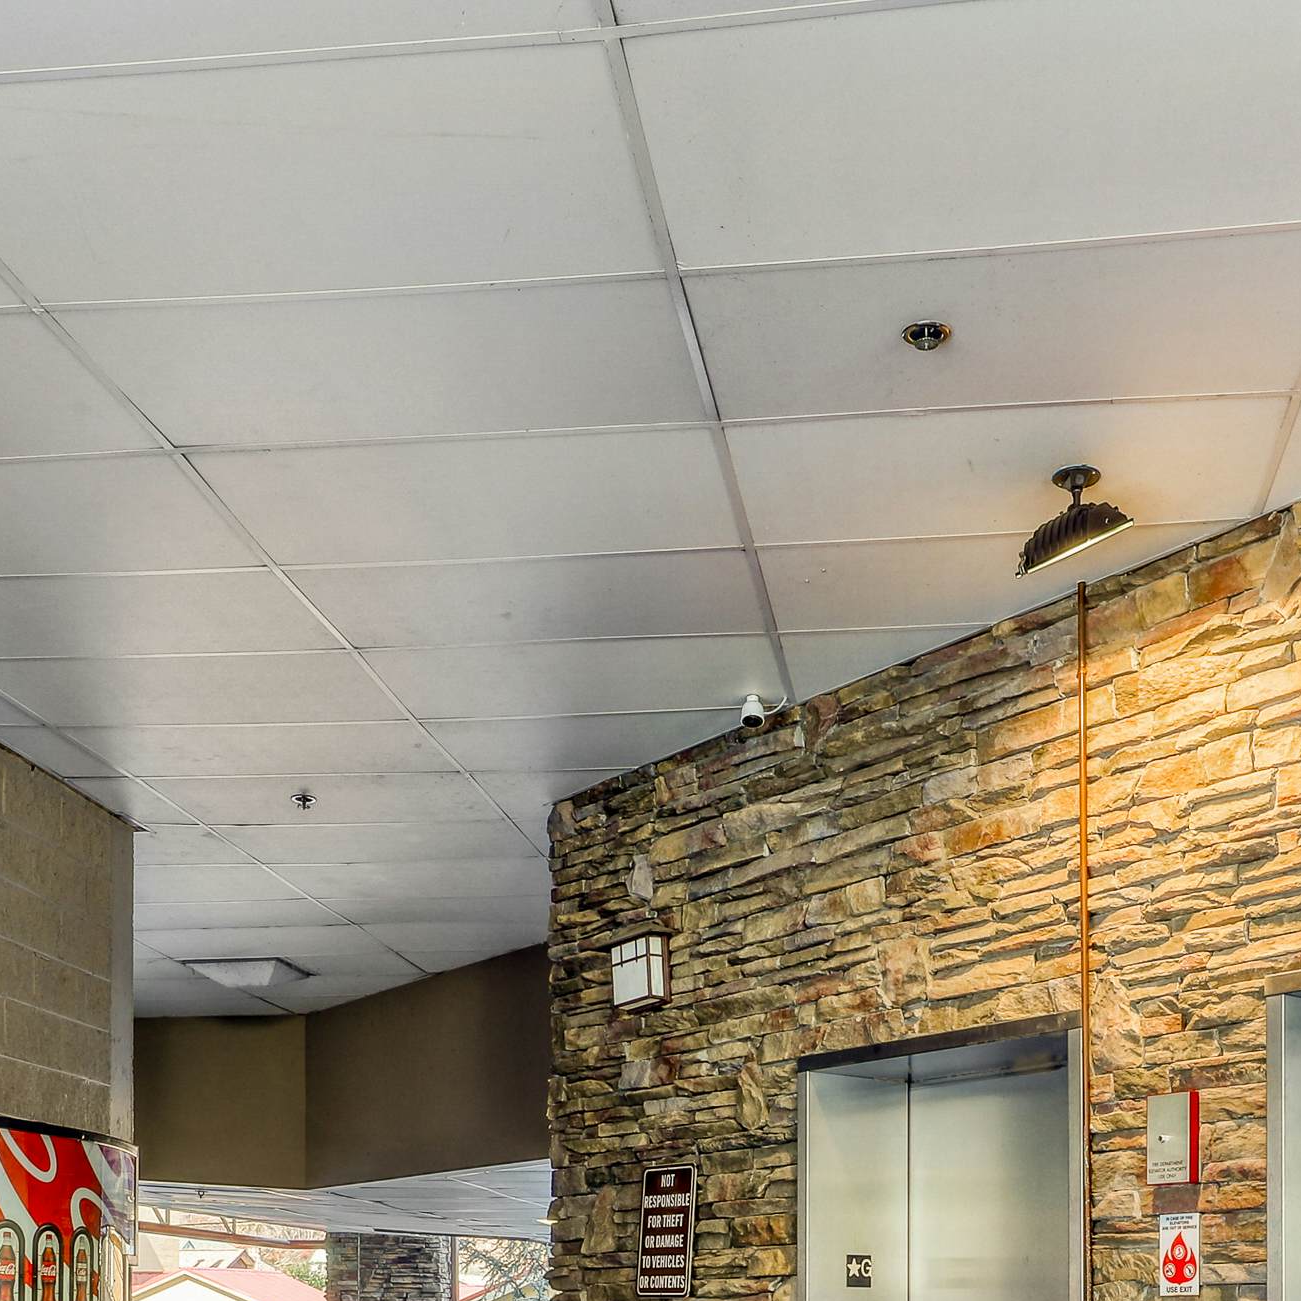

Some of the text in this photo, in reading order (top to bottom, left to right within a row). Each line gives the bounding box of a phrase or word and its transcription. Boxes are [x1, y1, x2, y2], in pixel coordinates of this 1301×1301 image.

[660, 1173, 675, 1188] NOT
[644, 1192, 691, 1209] RESPONSIBLE
[647, 1213, 684, 1229] FOR THEFT
[644, 1234, 684, 1248] OR DAMAGE
[642, 1254, 685, 1269] TO VEHICLES
[861, 1258, 872, 1277] G
[639, 1275, 685, 1289] OR CONTENTS
[1179, 1285, 1193, 1293] EXIT
